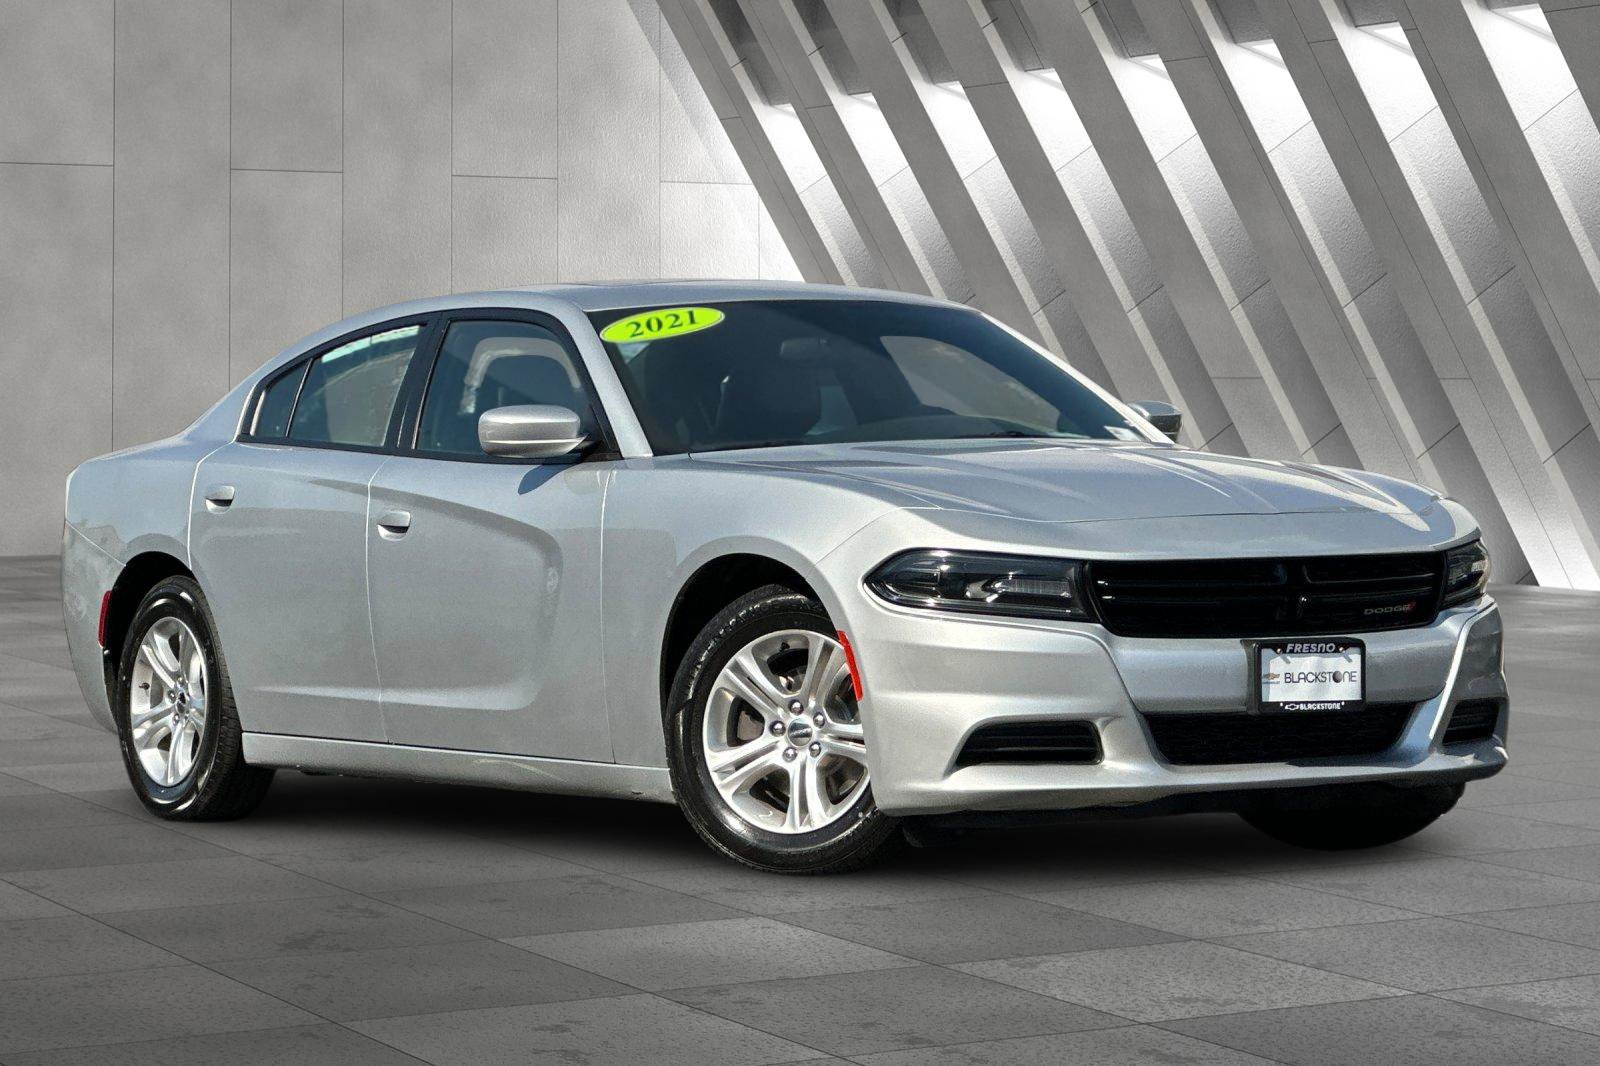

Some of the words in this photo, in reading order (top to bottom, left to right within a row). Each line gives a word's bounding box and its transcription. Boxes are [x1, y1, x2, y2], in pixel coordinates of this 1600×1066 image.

[626, 310, 697, 338] 2021
[1363, 604, 1409, 615] DODGE
[1286, 643, 1336, 653] FRESNO
[1284, 671, 1358, 683] BLACKSTONE
[1300, 702, 1341, 710] BLACKSTONE
